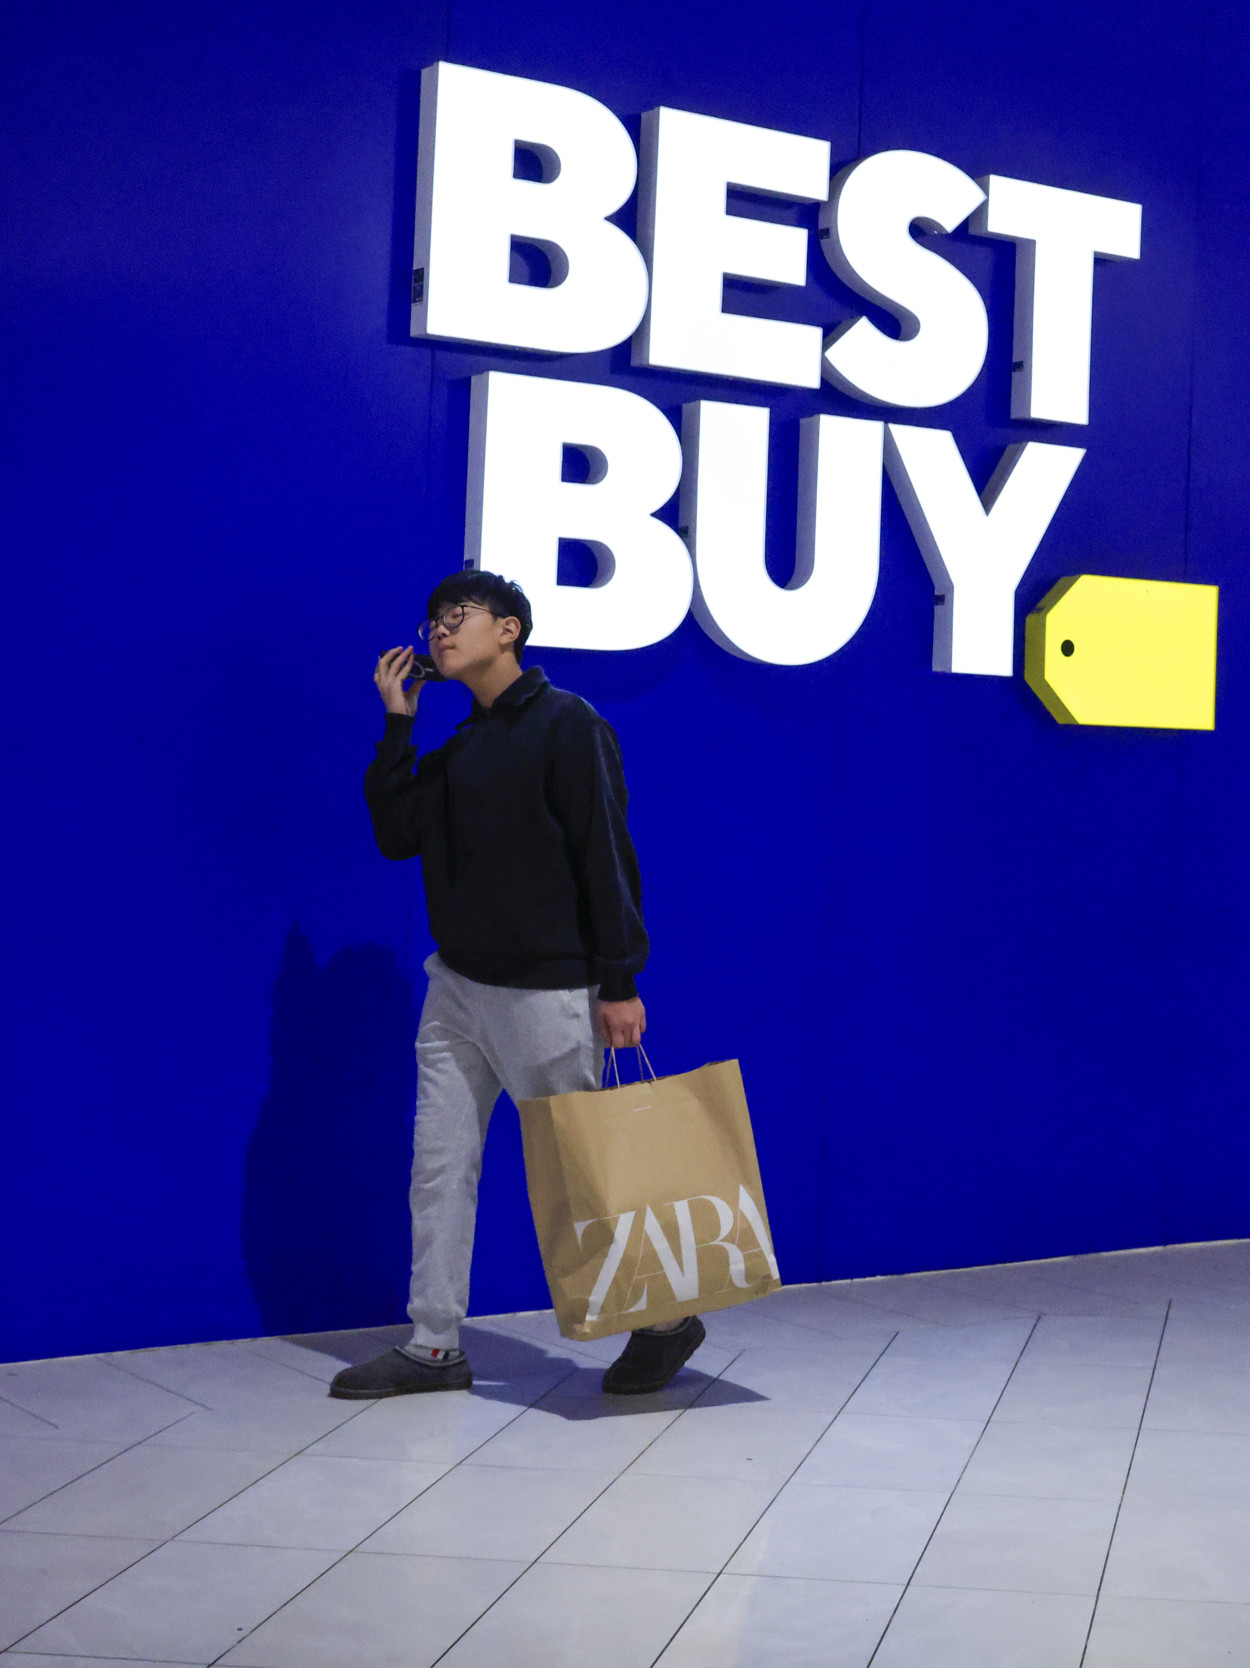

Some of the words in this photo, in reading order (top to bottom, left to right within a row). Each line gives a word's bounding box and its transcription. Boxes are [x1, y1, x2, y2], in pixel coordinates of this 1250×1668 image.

[411, 61, 1142, 425] BEST
[464, 371, 1086, 677] BUY
[573, 1184, 781, 1323] ZARA
